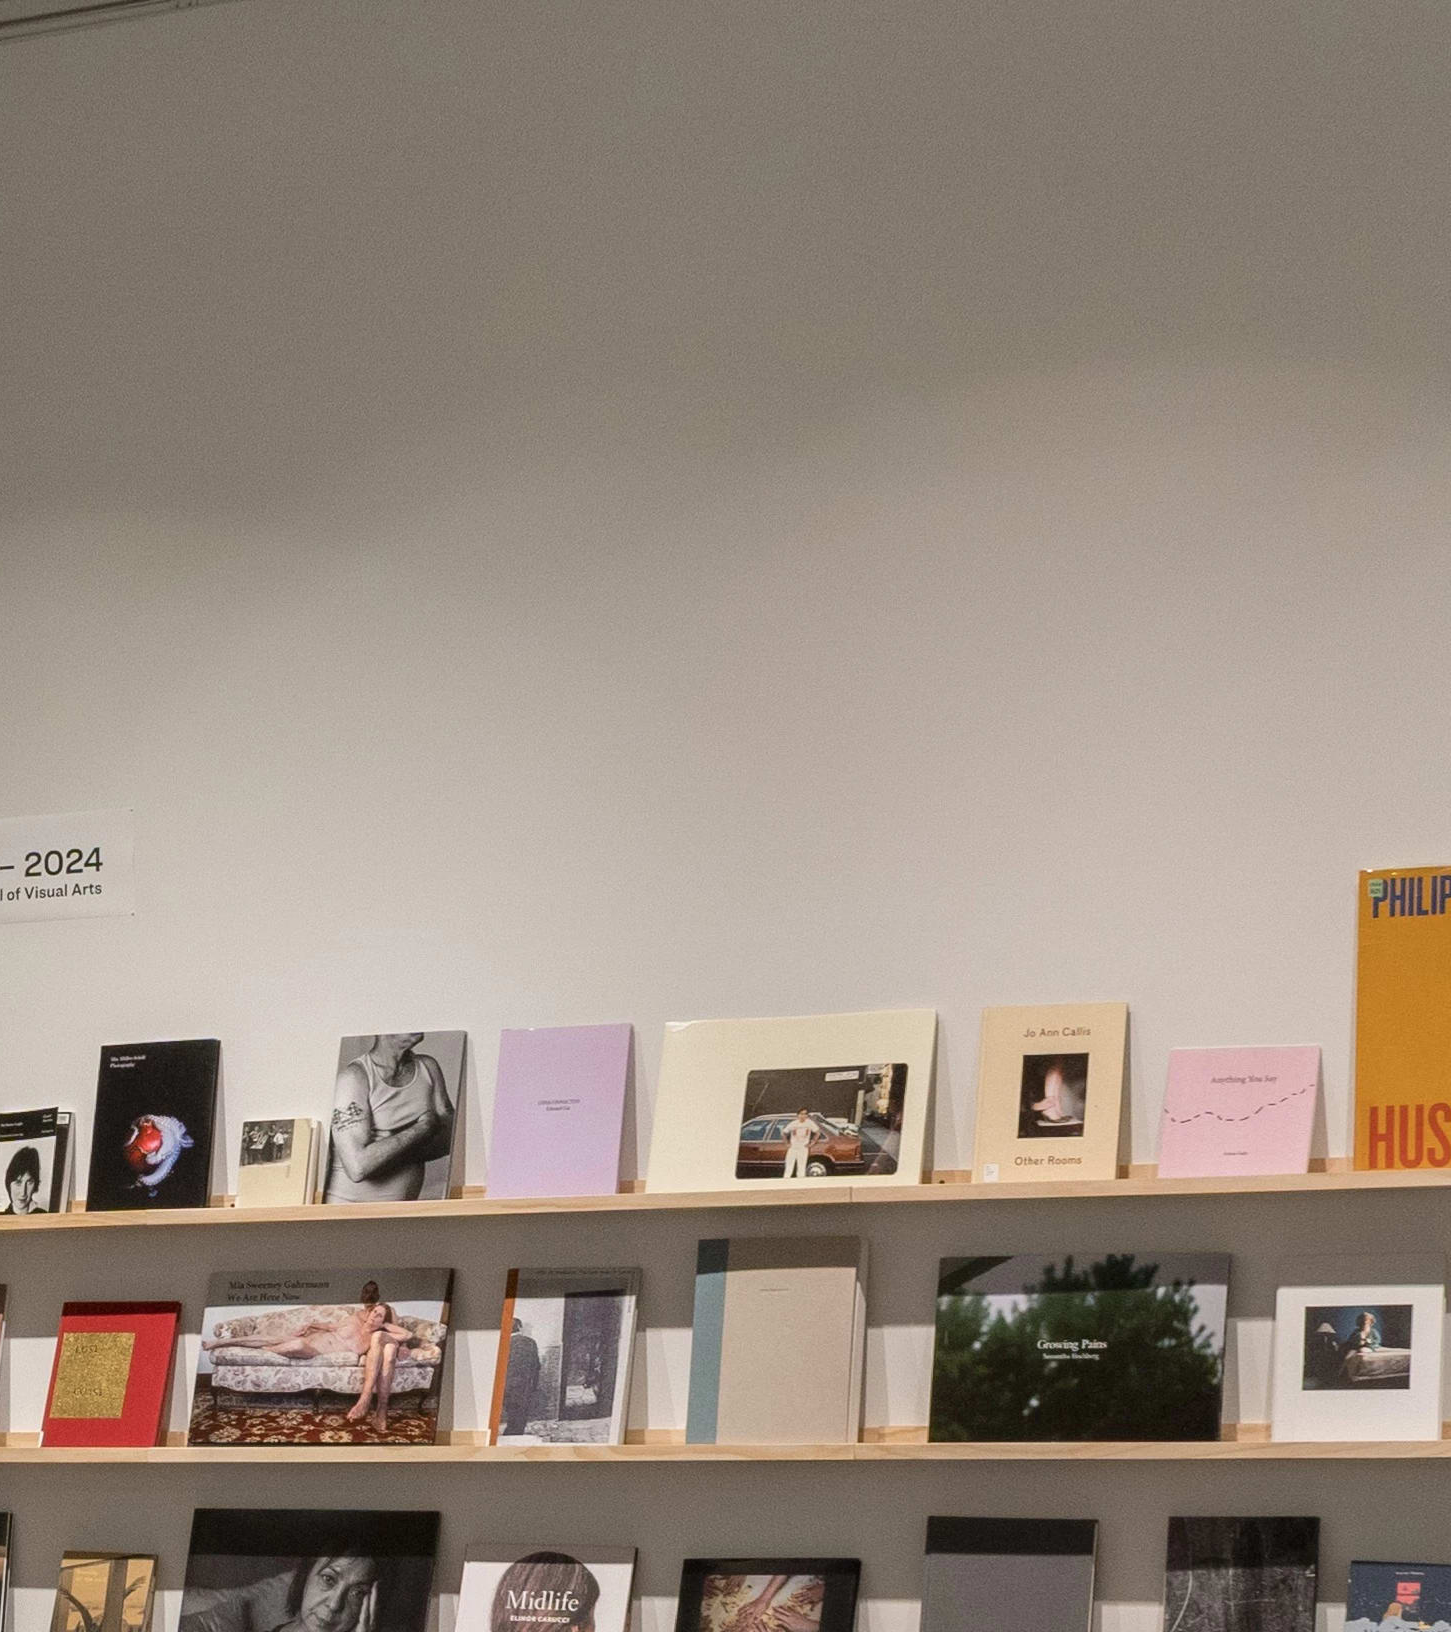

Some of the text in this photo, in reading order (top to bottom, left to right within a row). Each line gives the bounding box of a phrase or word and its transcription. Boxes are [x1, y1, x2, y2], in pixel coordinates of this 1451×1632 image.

[24, 847, 103, 877] 2024
[7, 886, 21, 901] of
[24, 883, 68, 899] Visual
[71, 882, 102, 897] Arts
[1023, 1026, 1092, 1038] Jo Ann Callis
[1014, 1155, 1083, 1166] Other Rooms
[1036, 1338, 1108, 1352] Growing Pains
[505, 1589, 580, 1612] Midlife
